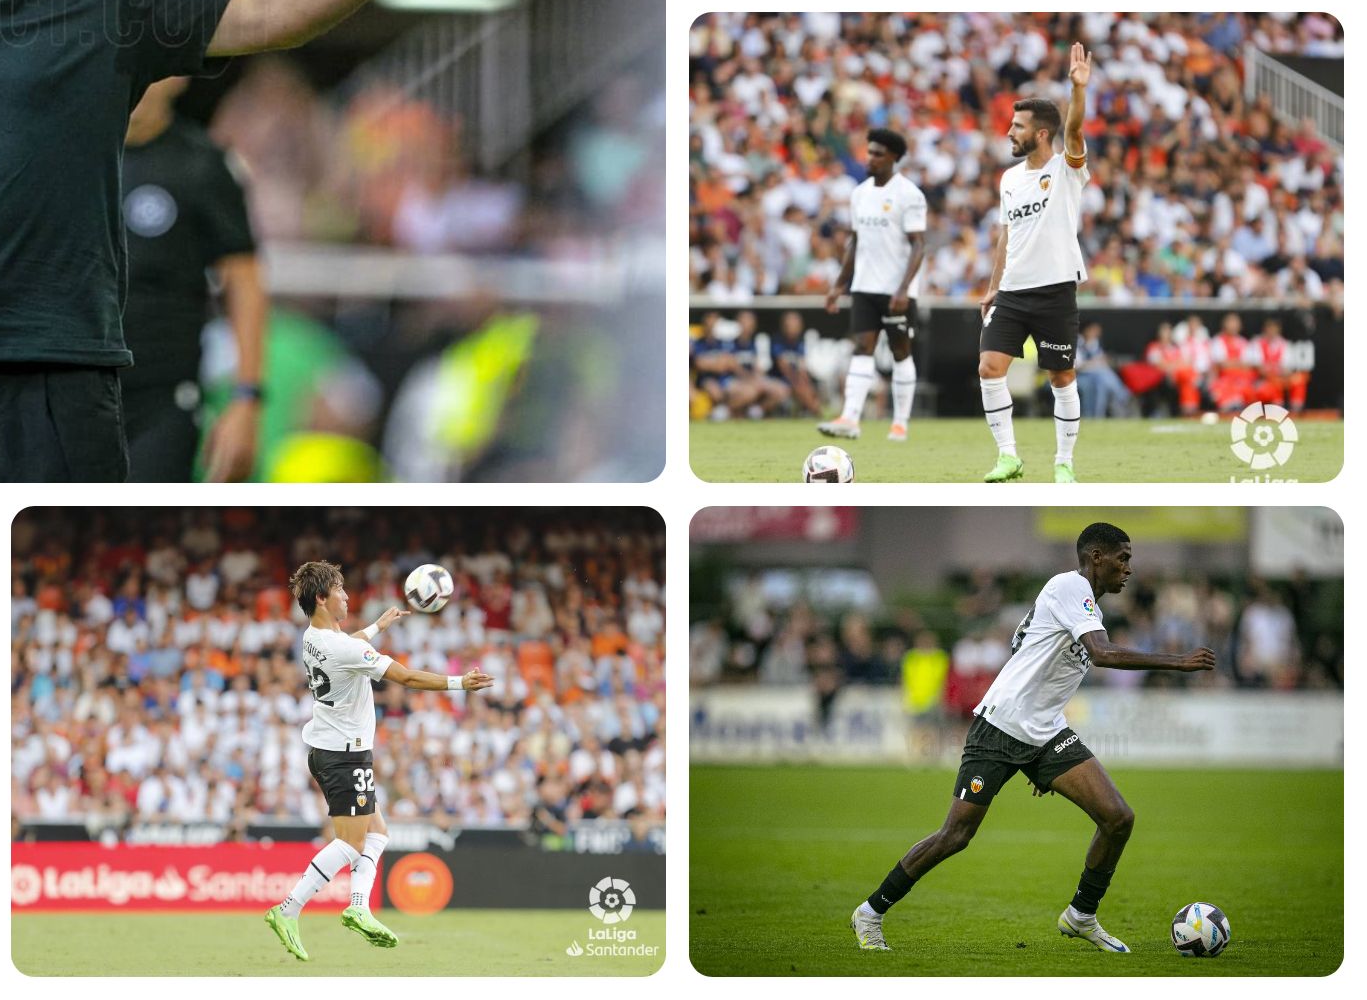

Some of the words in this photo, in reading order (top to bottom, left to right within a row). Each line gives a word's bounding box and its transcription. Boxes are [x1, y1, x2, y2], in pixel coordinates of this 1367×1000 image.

[1040, 341, 1073, 351] ŠKODA
[304, 641, 327, 665] ZQUEZ
[352, 768, 375, 792] 32
[43, 866, 155, 905] LaLiga
